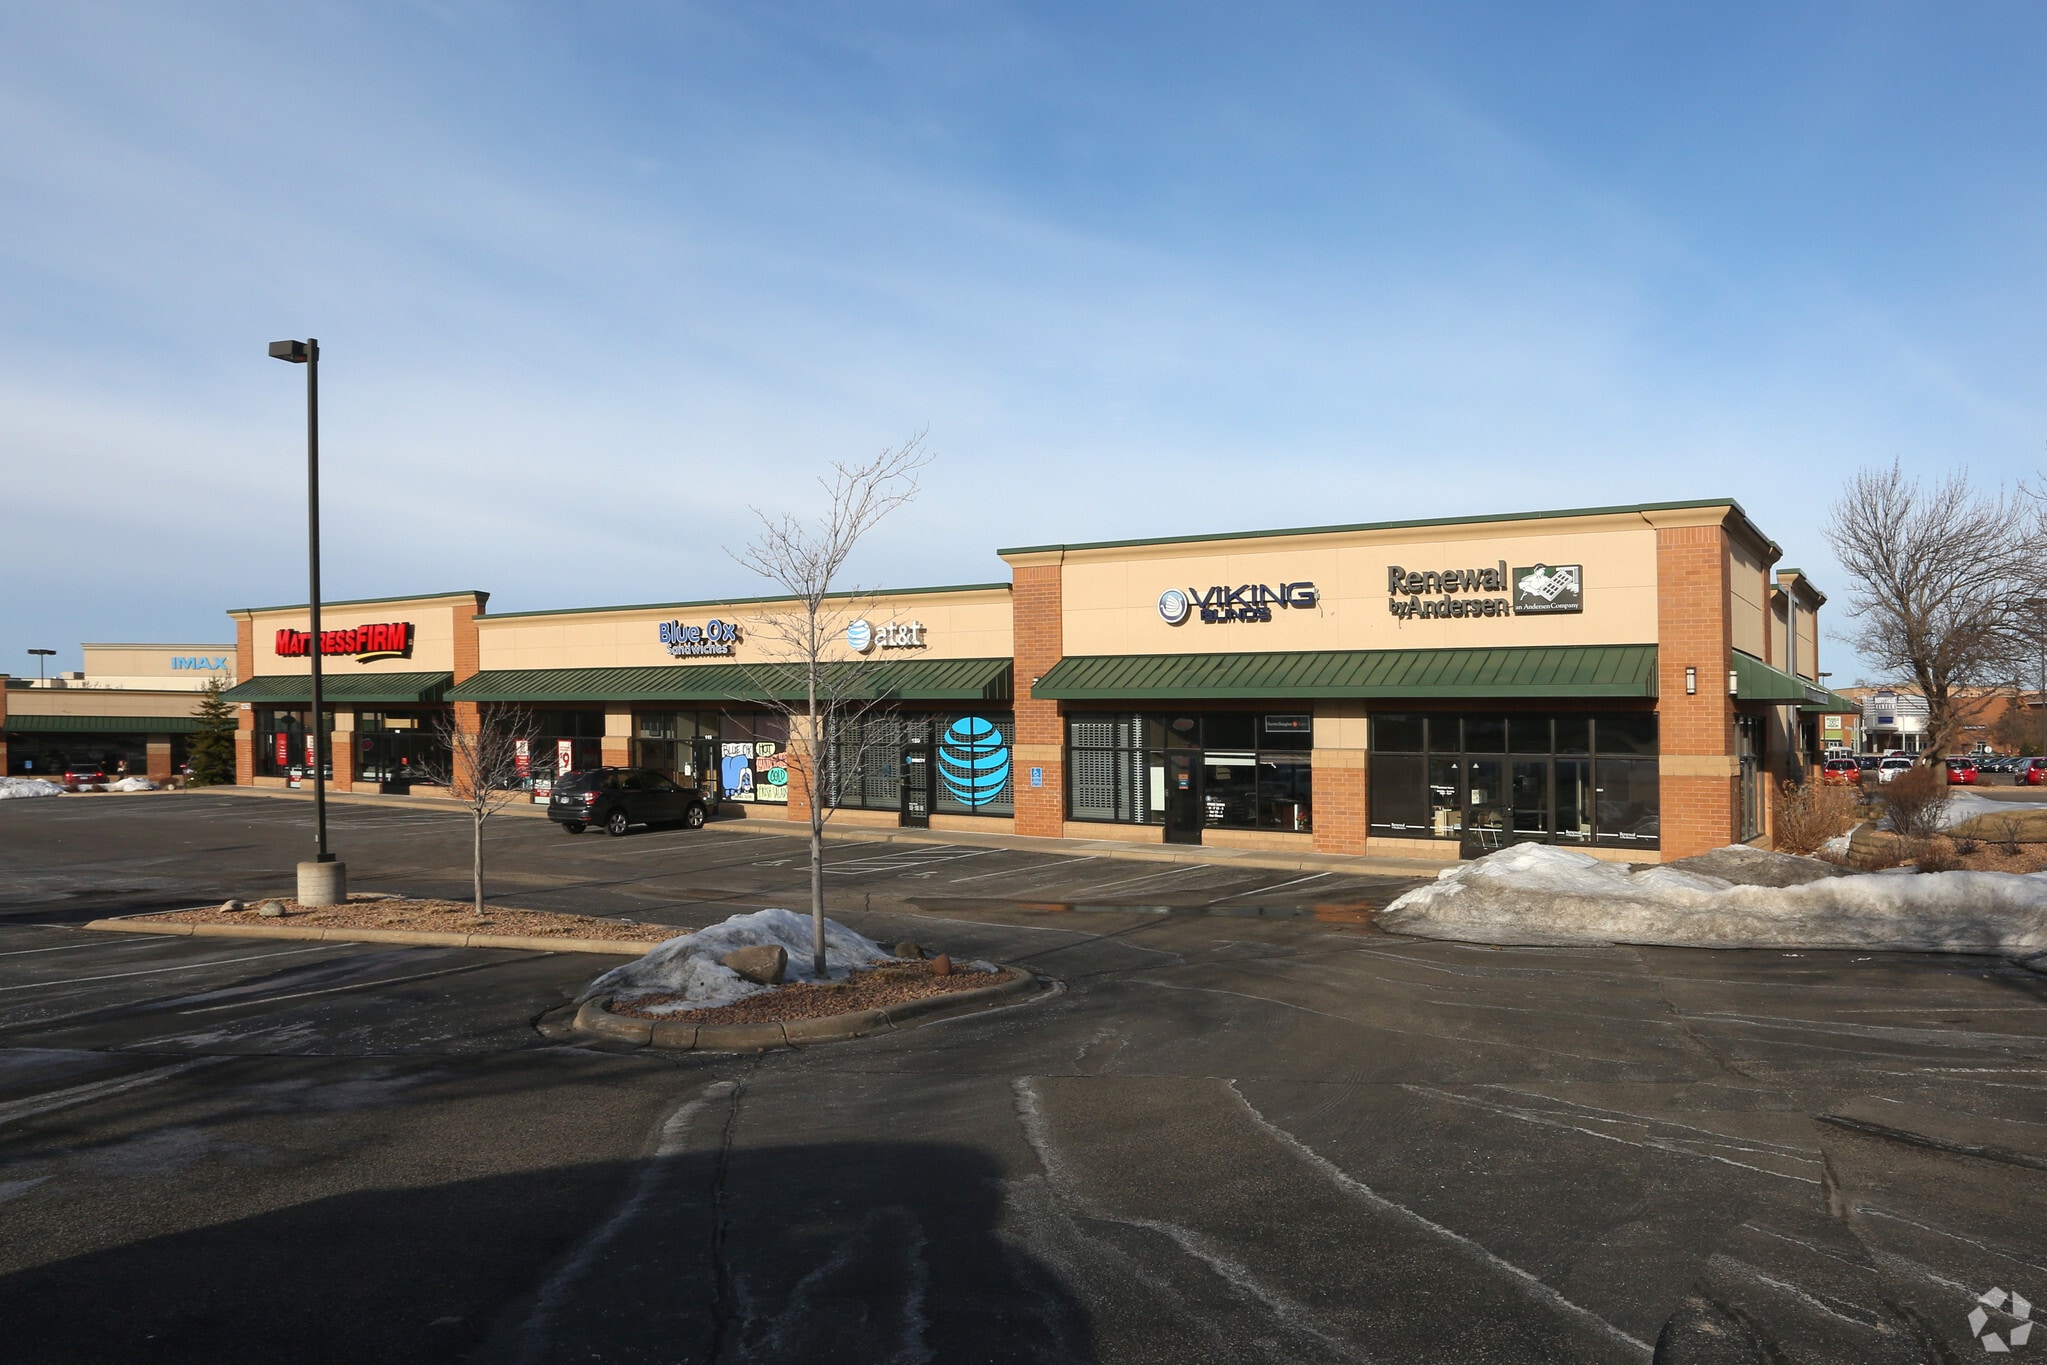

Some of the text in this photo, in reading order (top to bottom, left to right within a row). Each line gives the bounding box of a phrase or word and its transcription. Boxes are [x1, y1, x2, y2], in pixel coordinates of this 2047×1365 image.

[1387, 560, 1508, 594] Renewal
[1188, 582, 1316, 608] VIKING
[1200, 607, 1271, 621] BLINDS
[1388, 594, 1509, 619] by Andersen
[1523, 602, 1550, 610] Andersen
[1551, 602, 1578, 610] Company
[659, 619, 736, 644] Blue Ox
[874, 620, 922, 647] at&t
[667, 641, 728, 655] Sandwiches
[170, 657, 228, 671] IMAX
[758, 743, 773, 755] HOT
